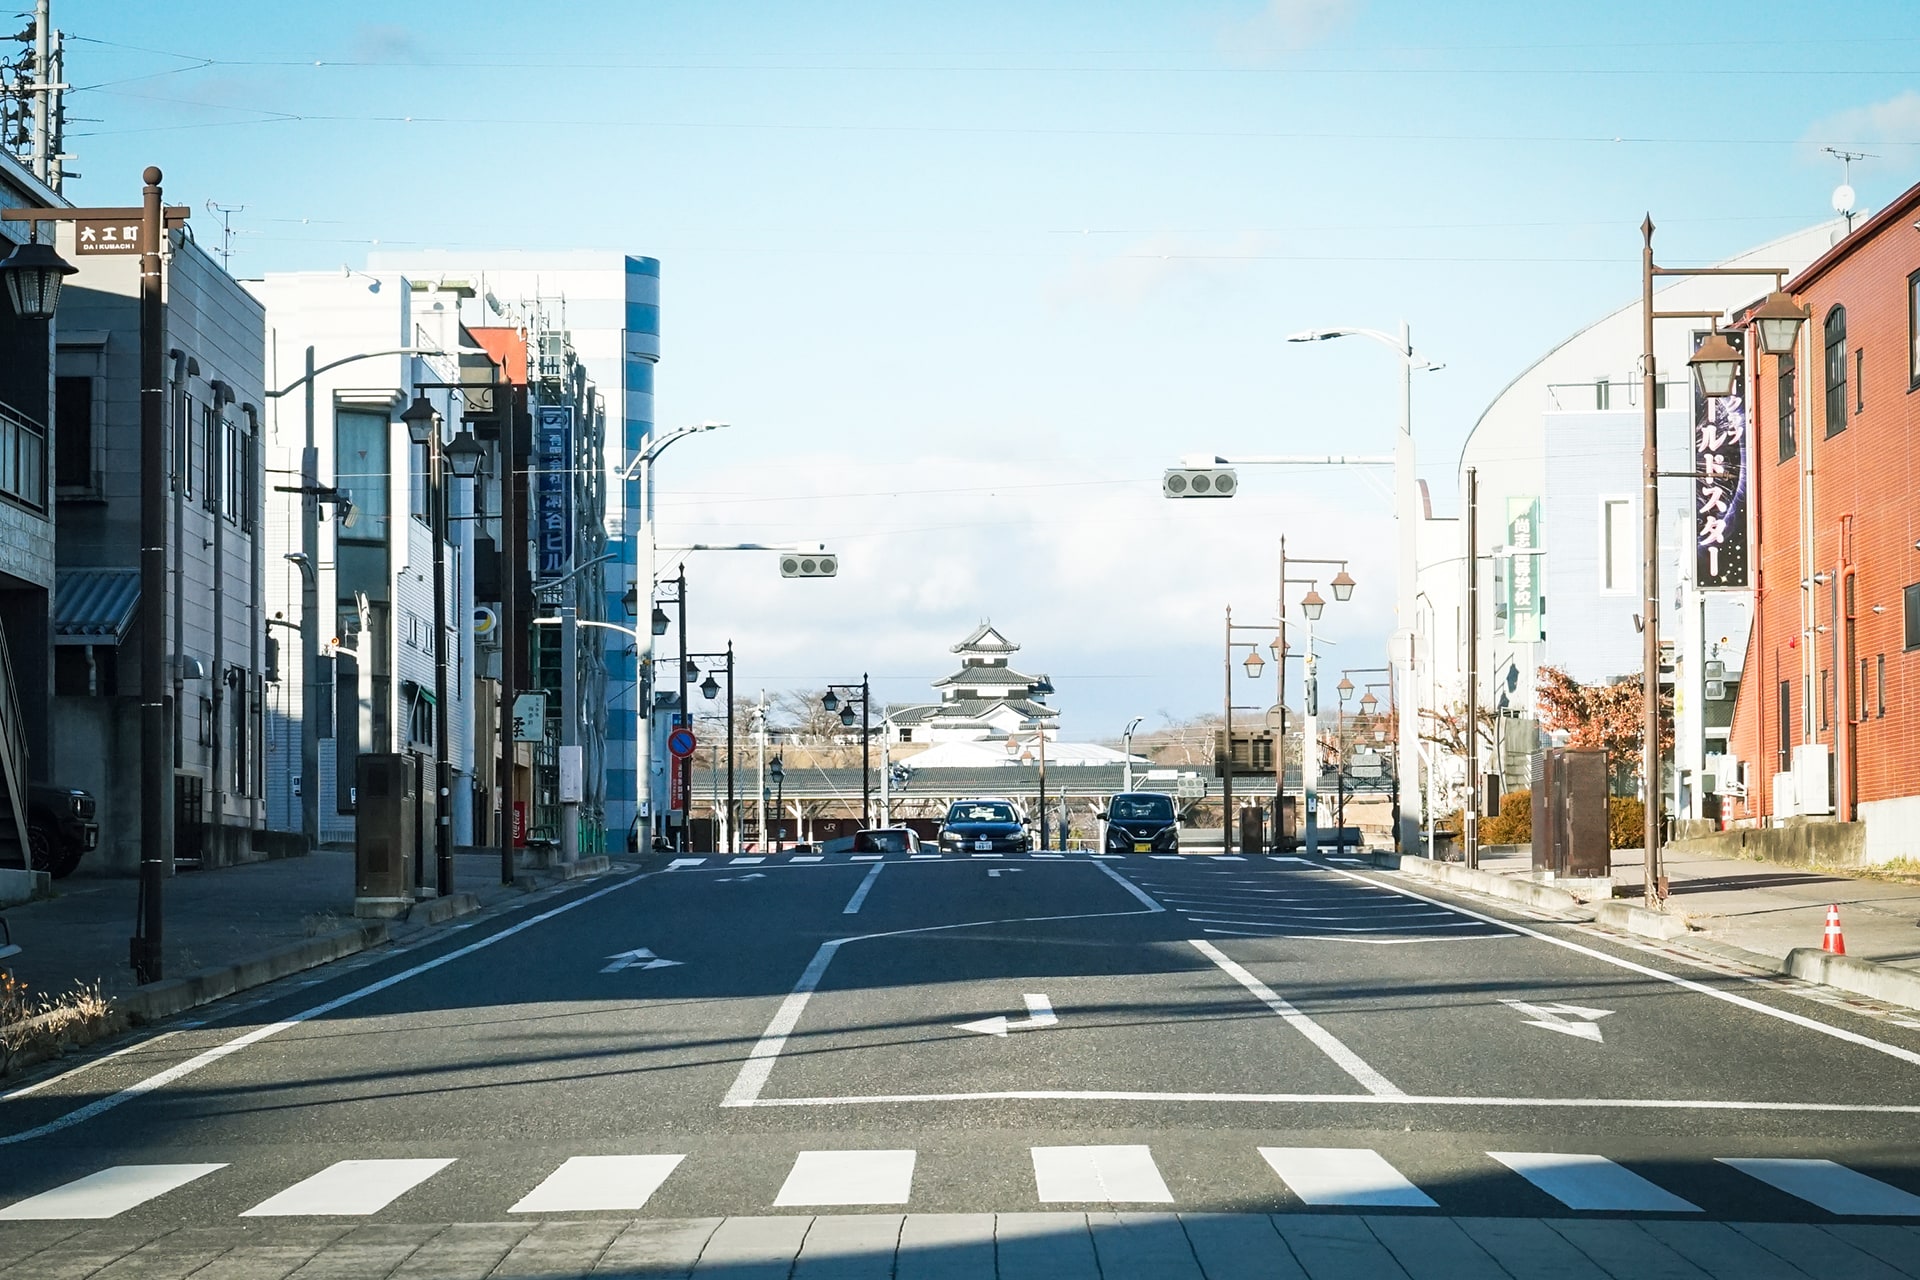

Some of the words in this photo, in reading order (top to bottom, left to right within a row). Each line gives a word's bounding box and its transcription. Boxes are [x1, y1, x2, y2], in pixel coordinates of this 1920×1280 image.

[80, 226, 139, 242] 大工町
[1698, 337, 1728, 577] ールドスター
[823, 823, 836, 831] JR
